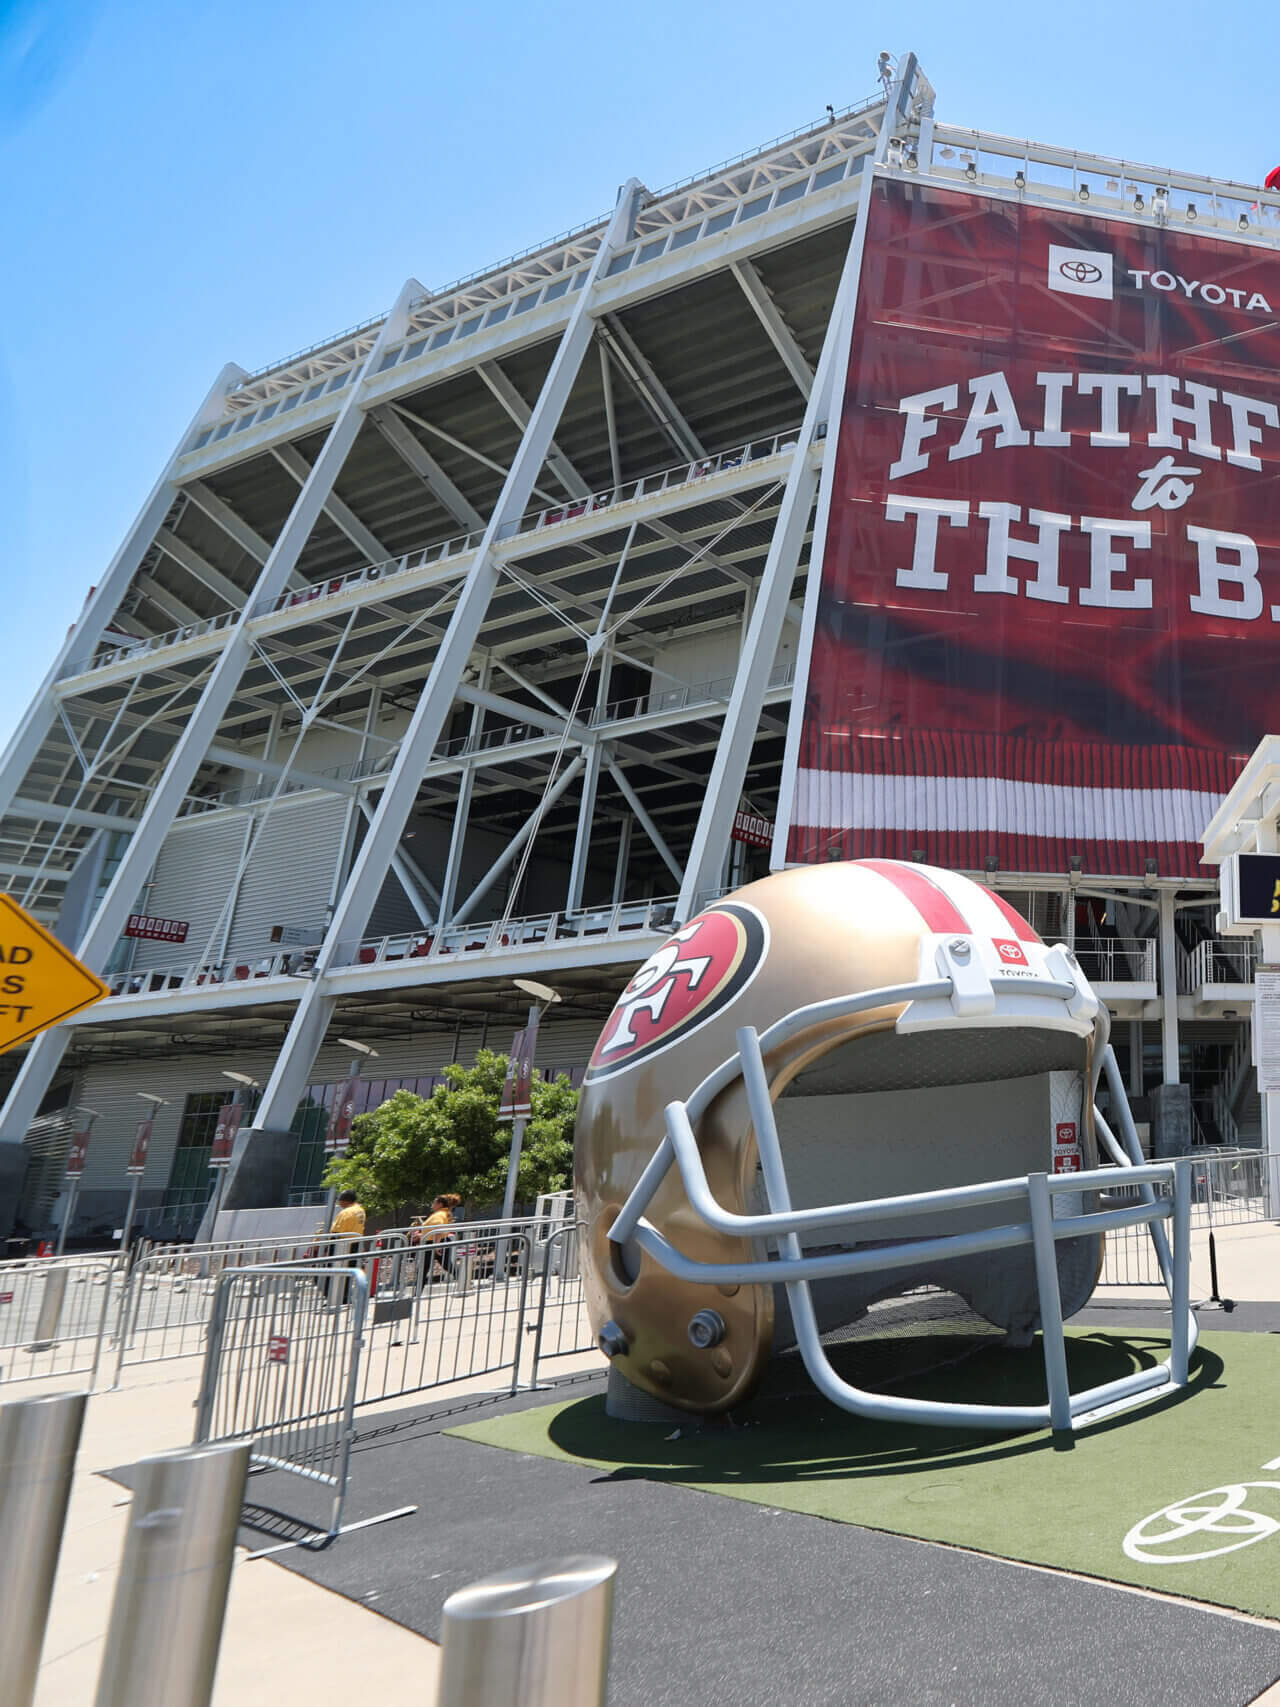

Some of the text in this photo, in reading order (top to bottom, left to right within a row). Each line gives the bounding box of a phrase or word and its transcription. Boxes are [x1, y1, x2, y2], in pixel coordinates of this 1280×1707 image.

[1127, 269, 1273, 313] TOYOTA
[1131, 455, 1202, 511] to
[885, 494, 1153, 609] THE
